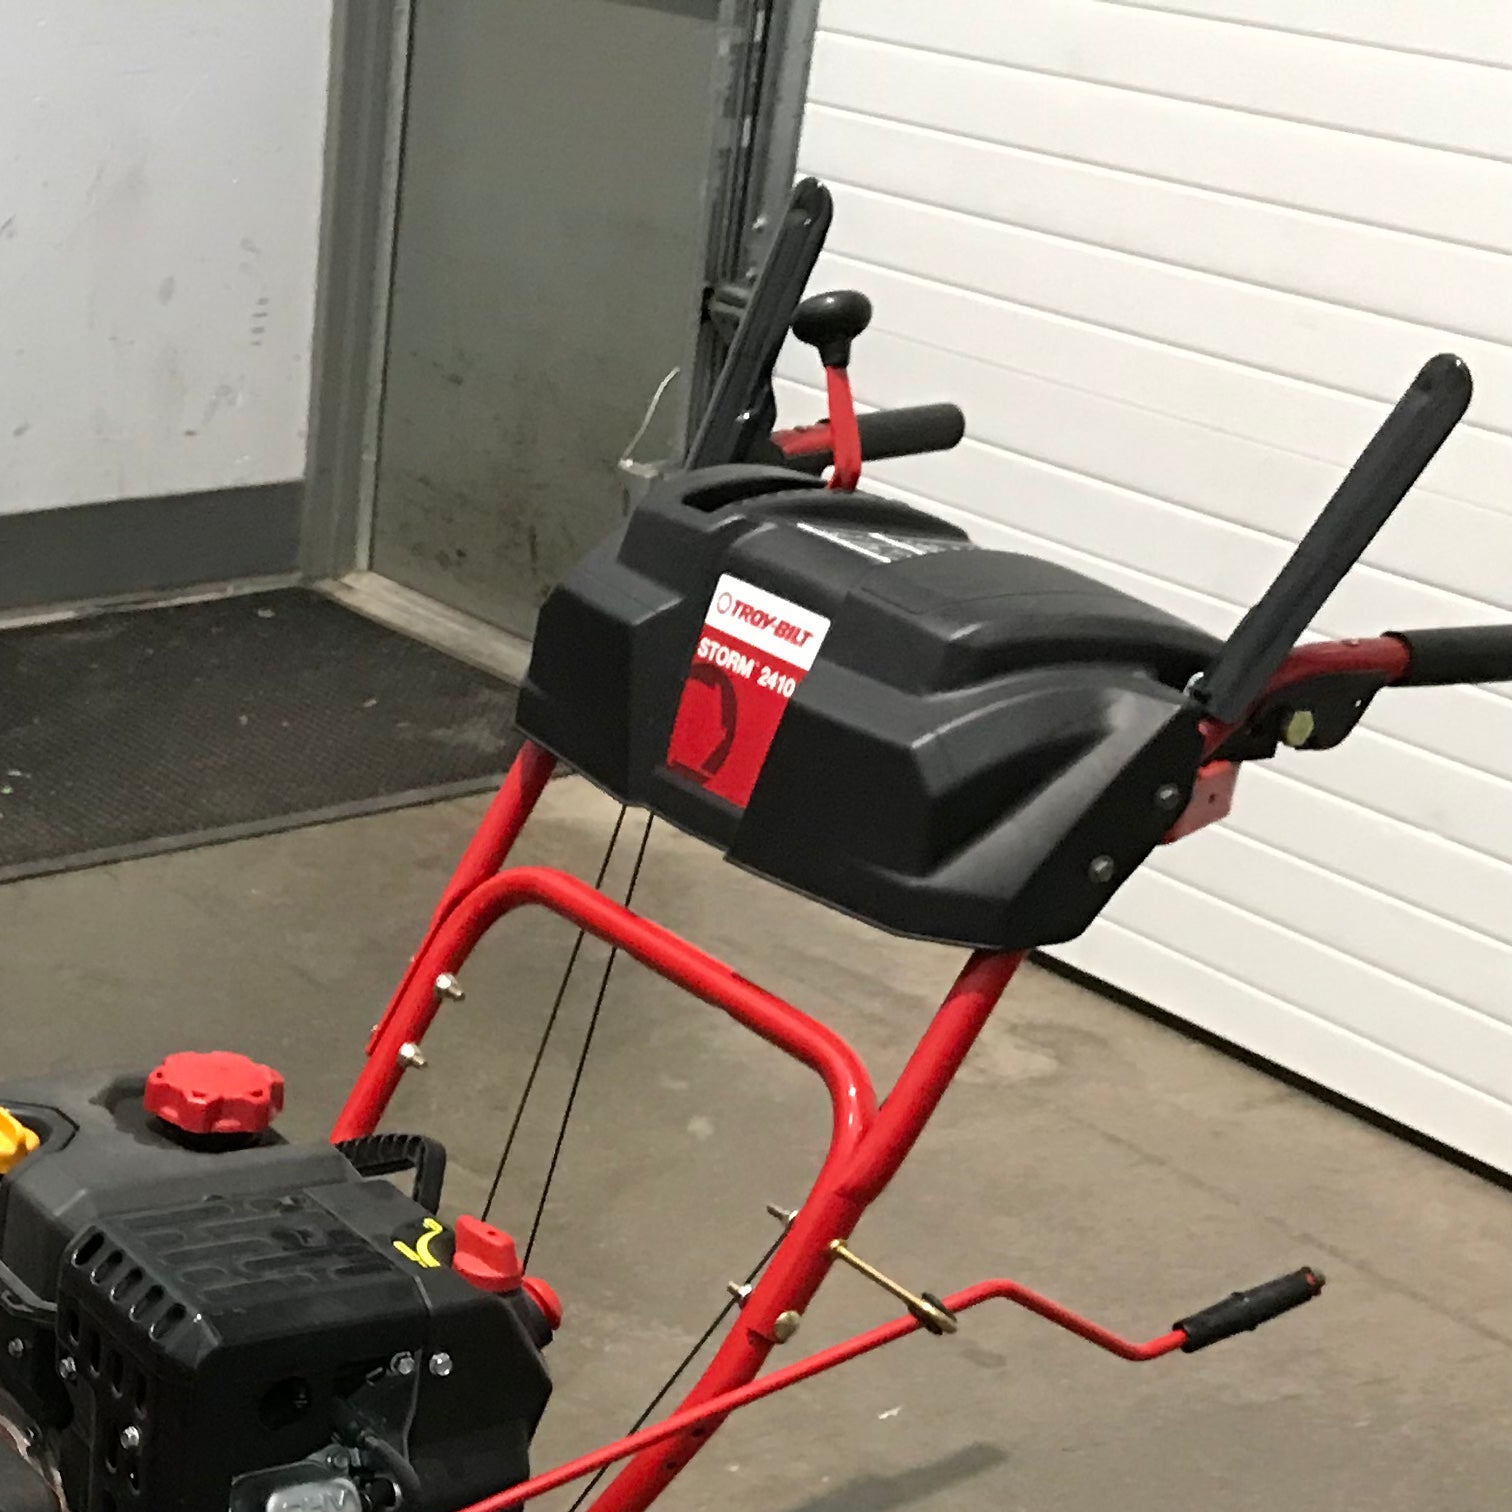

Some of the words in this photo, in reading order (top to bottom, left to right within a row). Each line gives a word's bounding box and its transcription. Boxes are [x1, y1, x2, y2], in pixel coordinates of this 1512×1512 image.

[731, 599, 814, 648] TROY-BILT
[696, 637, 755, 679] STORM
[757, 667, 796, 698] 2410
